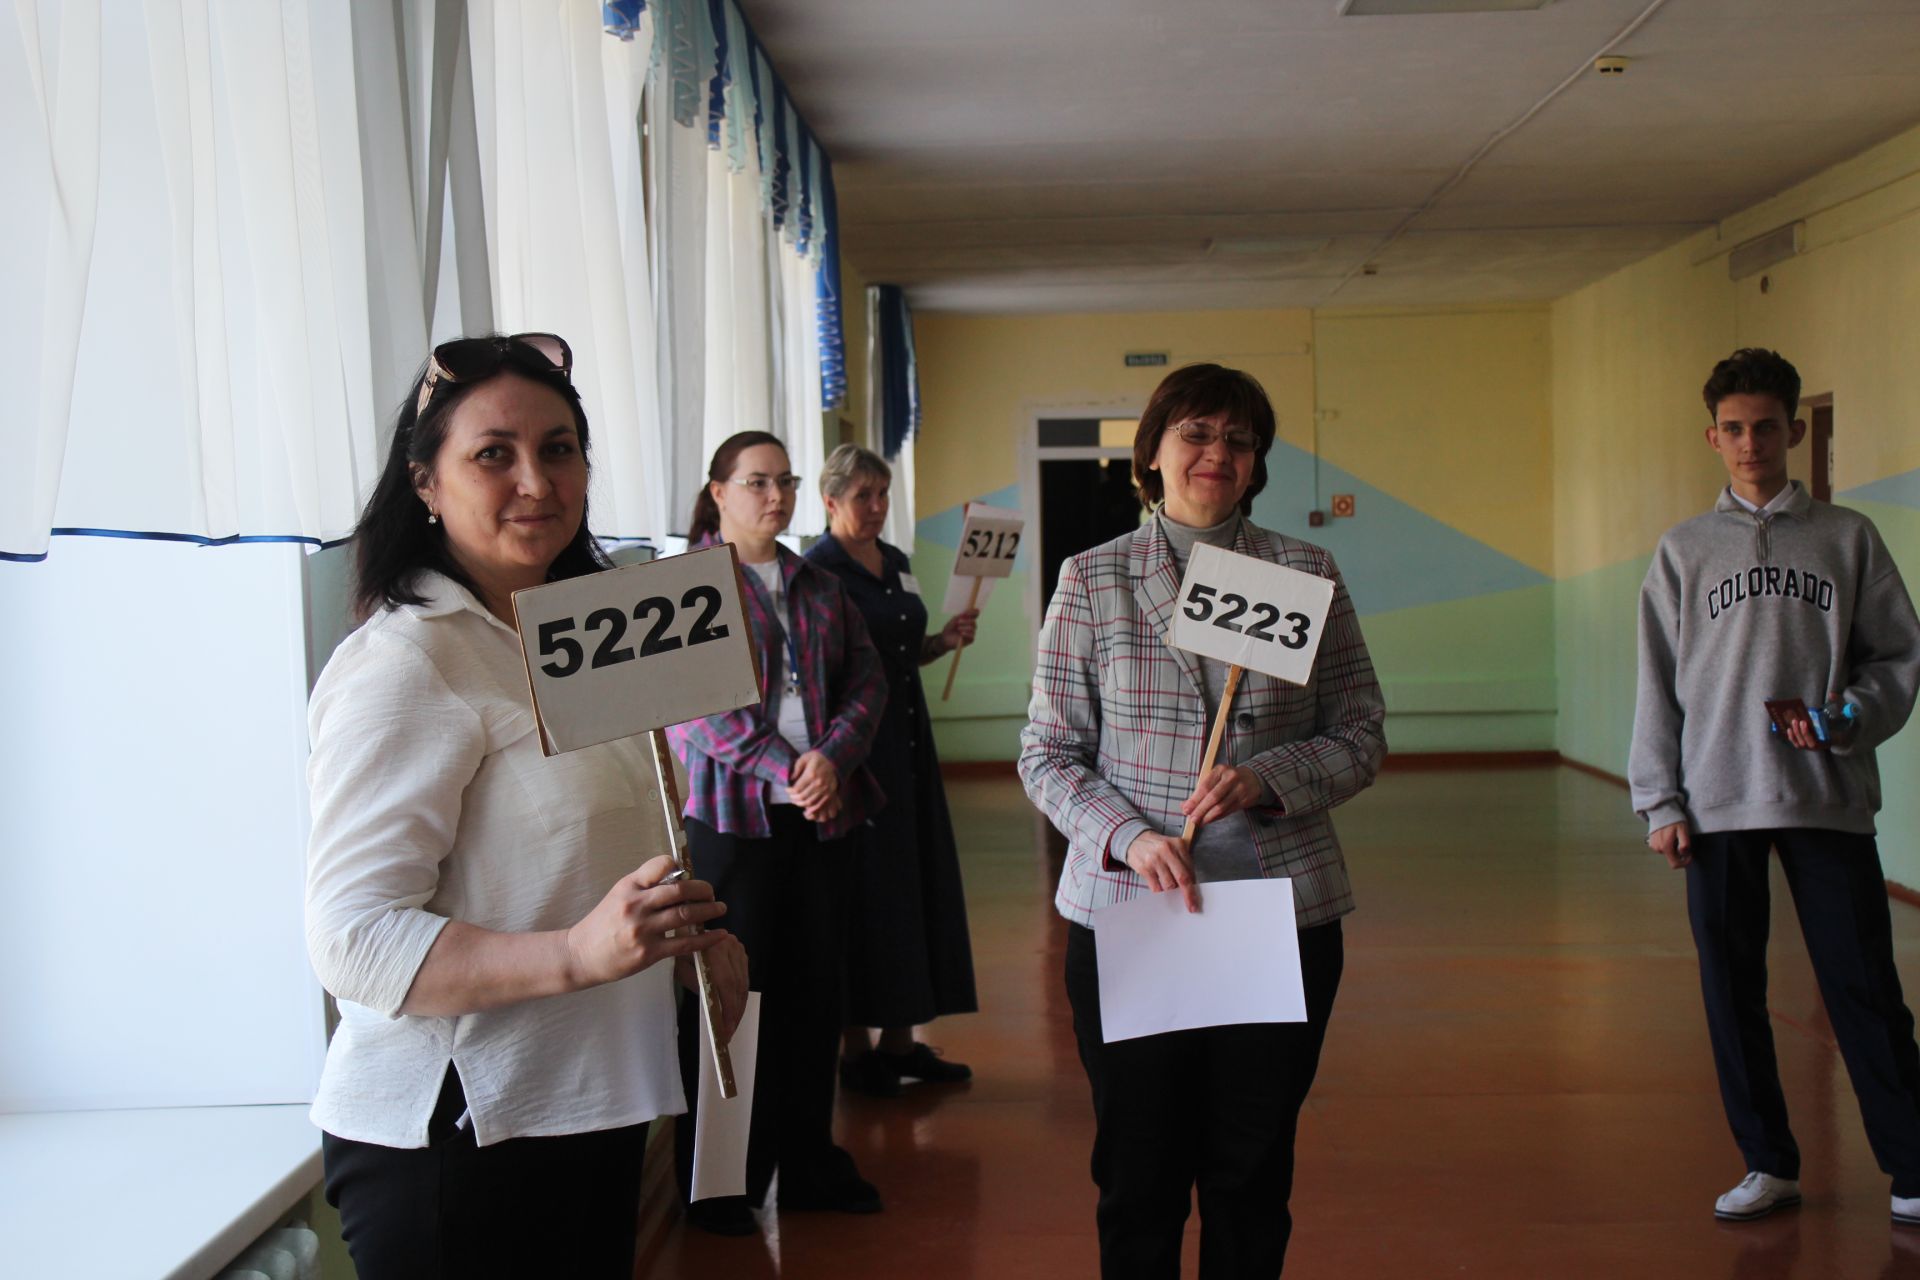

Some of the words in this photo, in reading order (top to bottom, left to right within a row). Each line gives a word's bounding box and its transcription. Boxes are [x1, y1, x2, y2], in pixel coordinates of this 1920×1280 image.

[963, 530, 1020, 559] 5212
[1183, 582, 1311, 650] 5223
[1707, 566, 1834, 620] COLORADO
[538, 585, 730, 678] 5222
